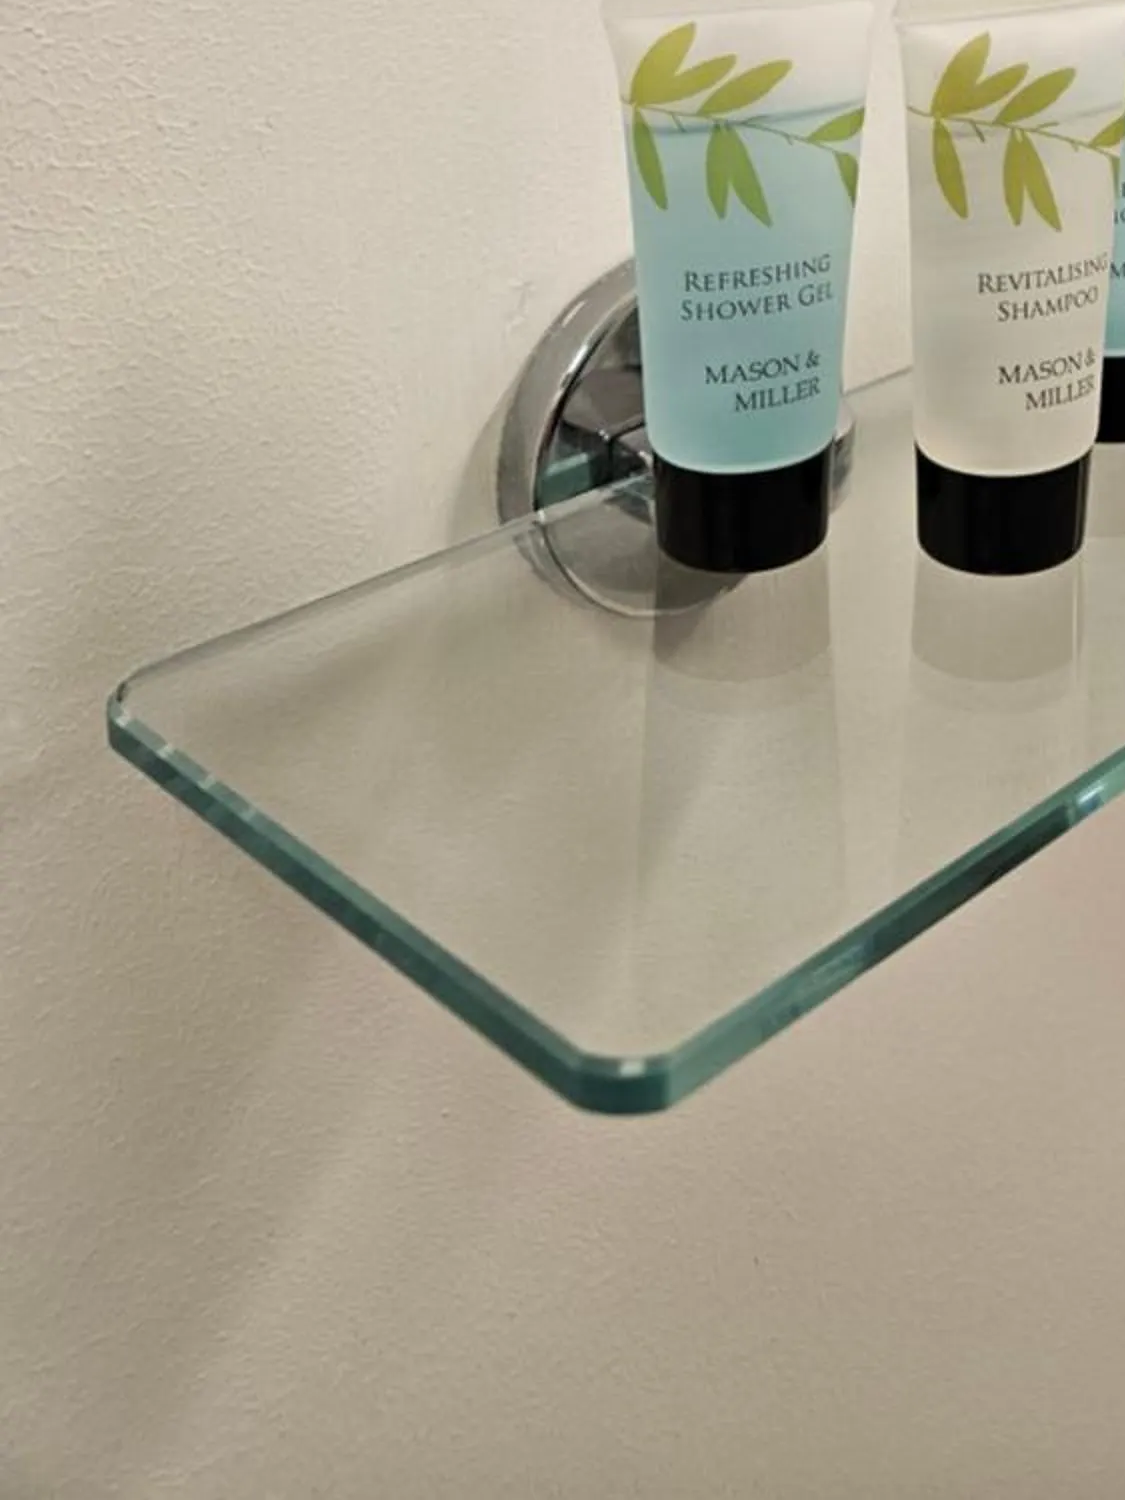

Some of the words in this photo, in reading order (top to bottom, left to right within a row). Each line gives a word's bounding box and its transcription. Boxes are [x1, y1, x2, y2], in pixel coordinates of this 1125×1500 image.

[683, 253, 832, 293] REFRESHING
[977, 251, 1109, 295] REVITALISING
[680, 291, 792, 322] SHOWER
[797, 280, 834, 307] GEL
[997, 284, 1099, 323] SHAMPOO
[704, 352, 801, 385] MASON
[804, 348, 821, 370] &
[997, 350, 1083, 385] MASON
[734, 376, 821, 413] MILLER
[1025, 373, 1096, 412] MILLER
